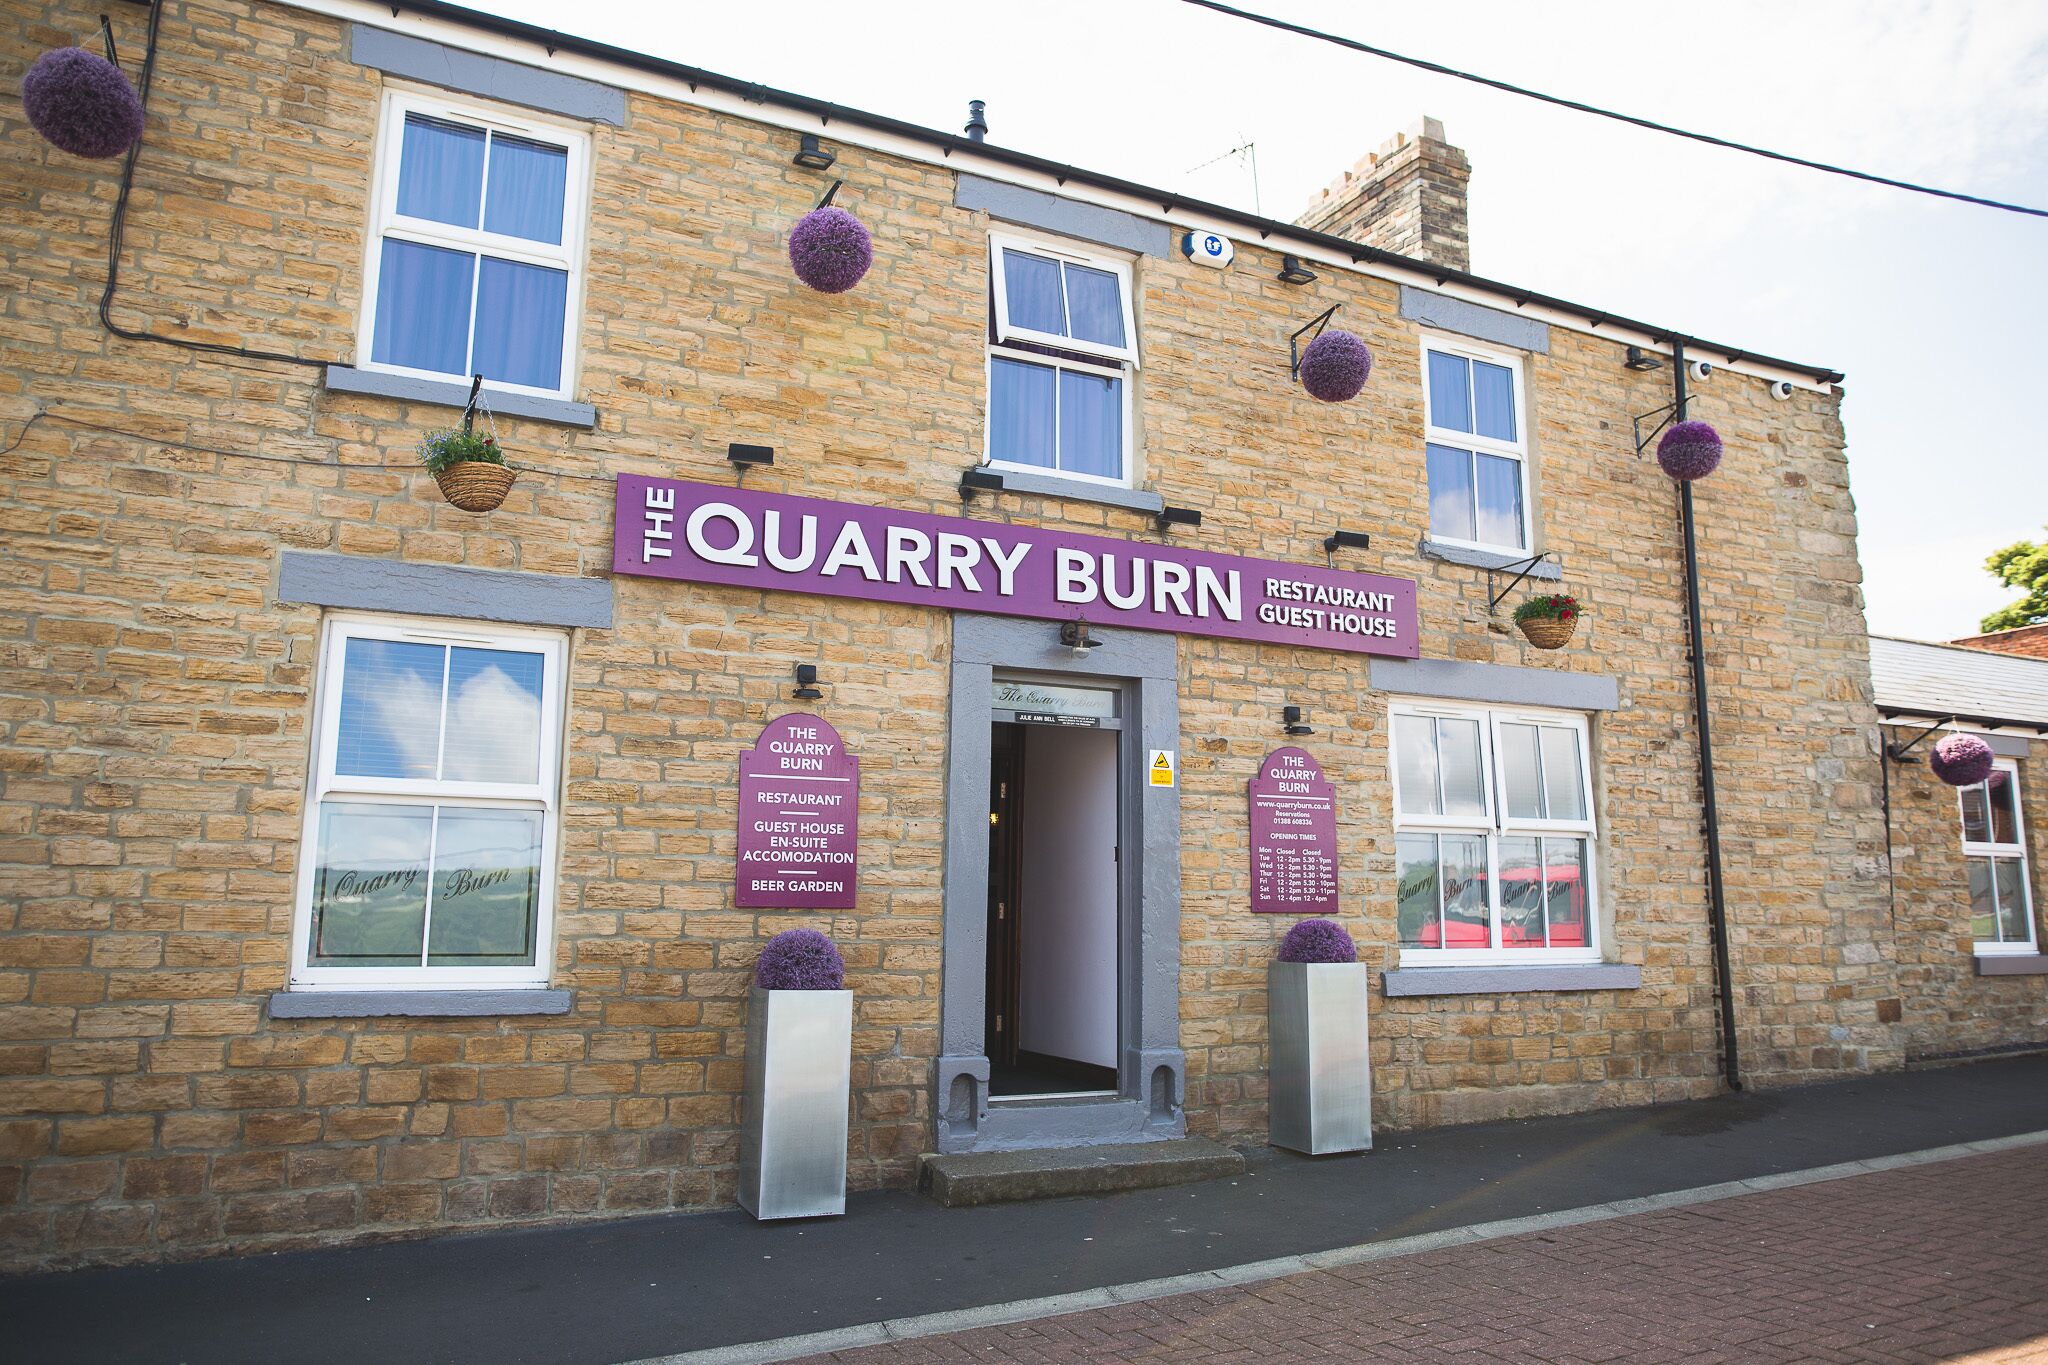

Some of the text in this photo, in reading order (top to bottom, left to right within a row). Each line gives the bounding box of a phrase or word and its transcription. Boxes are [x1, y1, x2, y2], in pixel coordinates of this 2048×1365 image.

[643, 487, 675, 563] THE
[686, 502, 1242, 621] QUARRY BURN
[1266, 577, 1394, 612] RESTAURANT
[1259, 603, 1397, 638] GUEST HOUSE
[999, 688, 1023, 702] The
[1027, 690, 1068, 707] Quarry
[788, 726, 816, 739] THE
[769, 741, 834, 755] QUARRY
[780, 758, 823, 771] BURN
[1282, 756, 1304, 767] THE
[1271, 769, 1317, 781] QUARRY
[1279, 782, 1310, 793] BURN
[757, 792, 842, 806] RESTAURANT
[1257, 801, 1330, 810] www.quarryburn.co.uk
[754, 821, 844, 835] GUEST HOUSE
[770, 837, 828, 848] EN-SUITE
[743, 850, 854, 864] ACCOMODATION
[333, 864, 511, 903] Quarry Burn
[751, 880, 843, 893] BEER GARDEN
[1397, 875, 1472, 904] Quarry Burn
[1547, 881, 1573, 902] Burn
